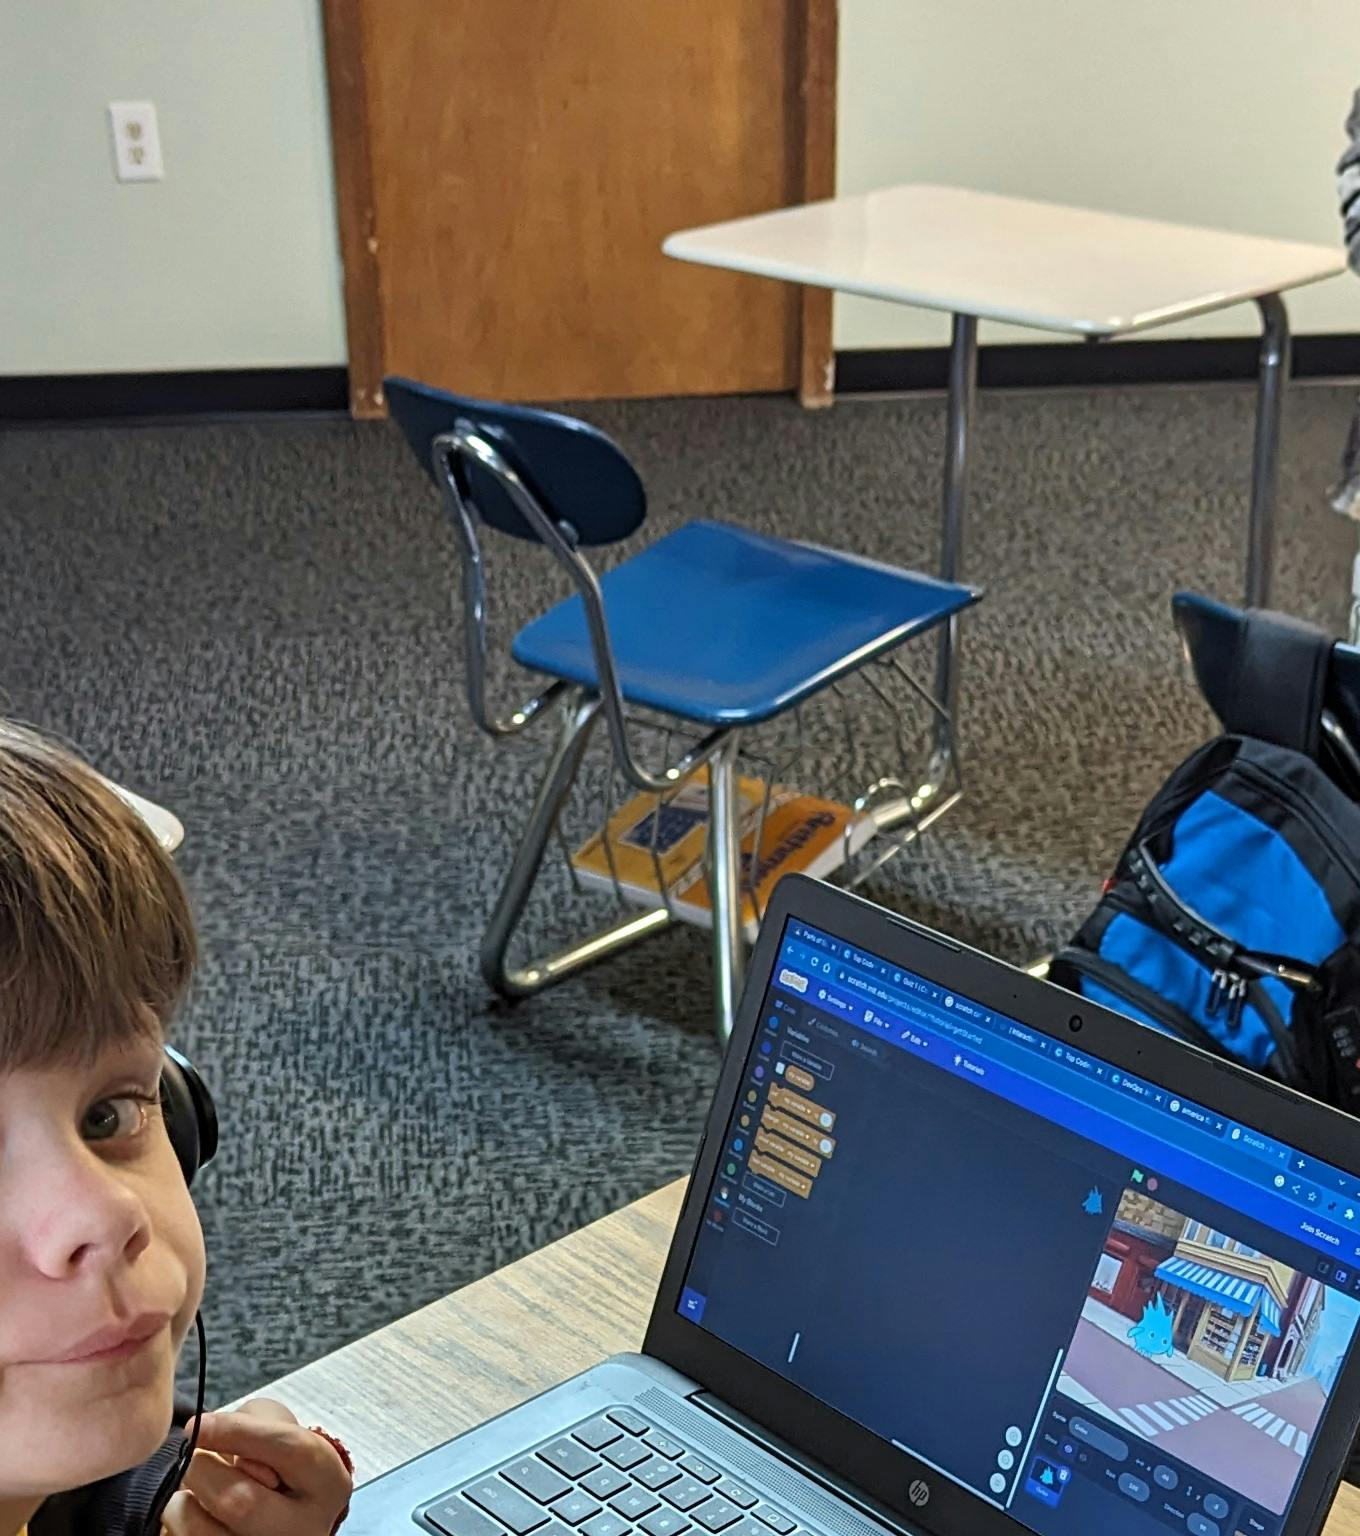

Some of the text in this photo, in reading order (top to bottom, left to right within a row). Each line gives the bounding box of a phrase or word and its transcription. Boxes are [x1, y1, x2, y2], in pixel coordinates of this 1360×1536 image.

[1122, 1078, 1143, 1094] DevOps
[1181, 1107, 1204, 1122] america
[1243, 1134, 1265, 1150] Scratch
[1299, 1219, 1339, 1247] Join Scratch
